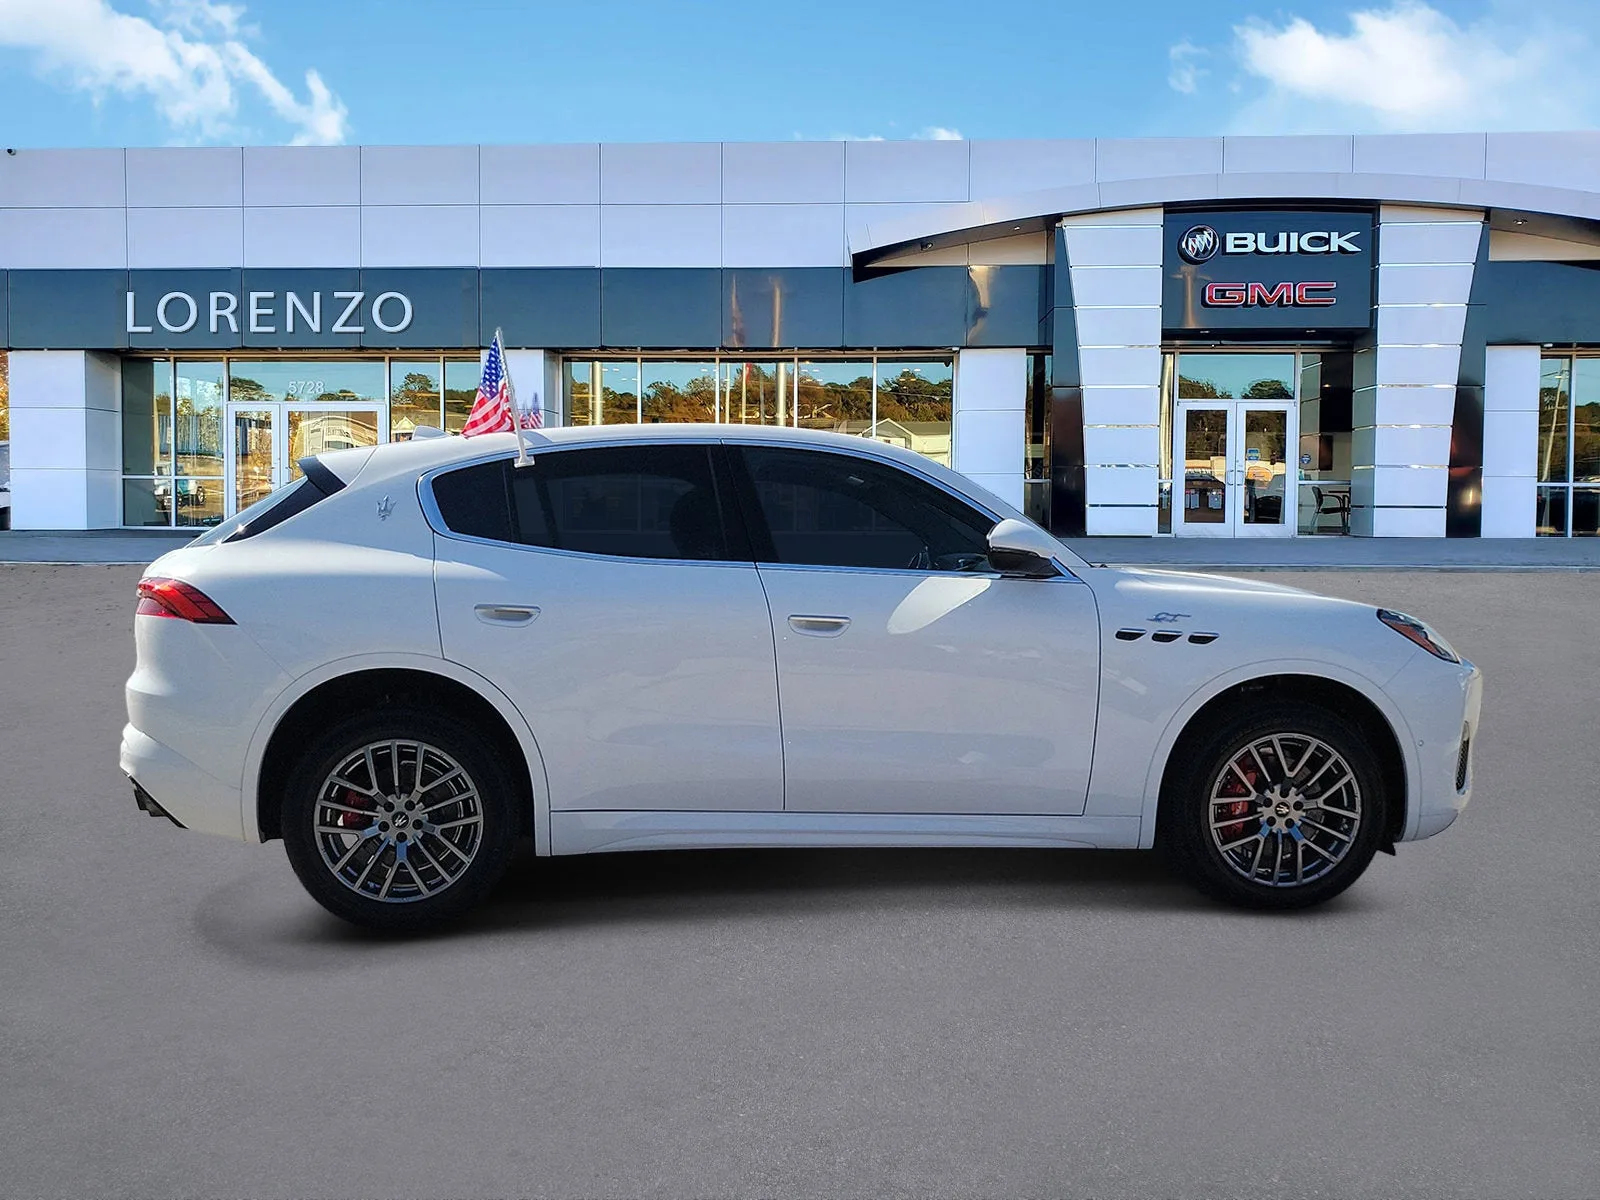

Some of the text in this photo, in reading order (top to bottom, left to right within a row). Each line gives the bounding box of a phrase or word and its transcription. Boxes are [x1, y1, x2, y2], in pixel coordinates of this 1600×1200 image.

[1225, 231, 1362, 253] BUICK
[1205, 282, 1337, 305] GMC
[126, 291, 413, 333] LORENZO
[288, 381, 325, 394] 5728
